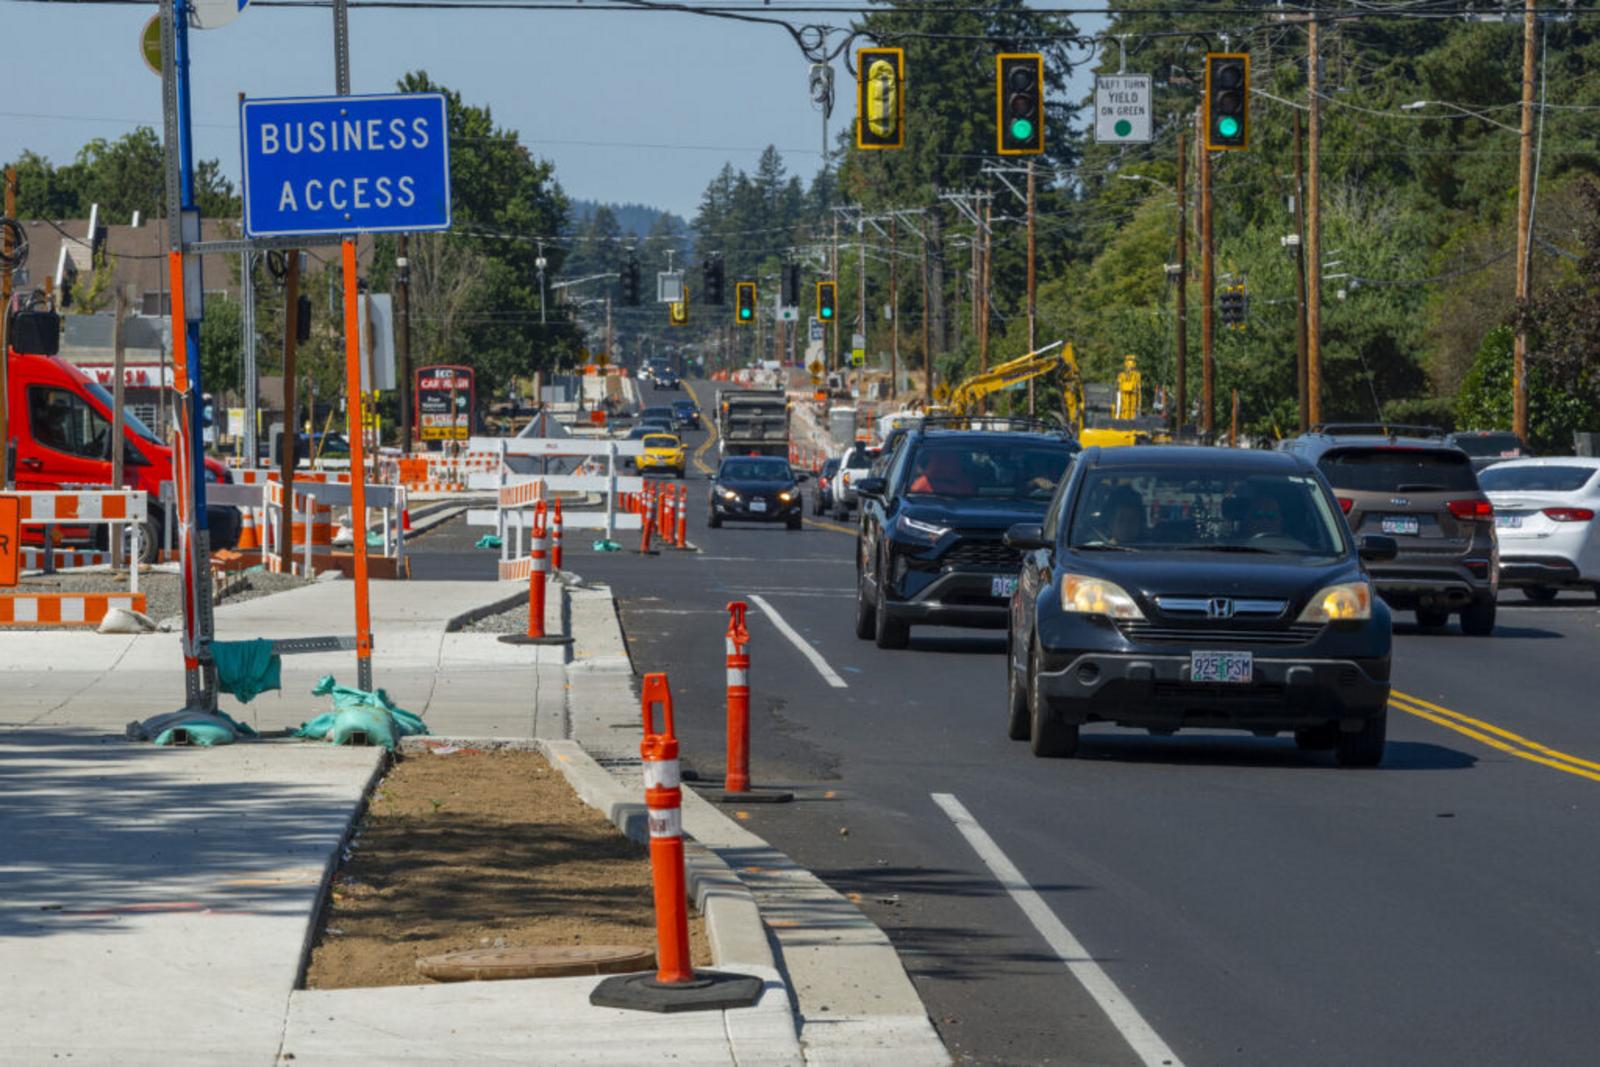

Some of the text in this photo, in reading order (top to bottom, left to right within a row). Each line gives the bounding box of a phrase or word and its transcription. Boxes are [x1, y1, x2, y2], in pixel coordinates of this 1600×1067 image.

[1100, 79, 1146, 89] LEFT TURN
[1108, 91, 1139, 104] YIELD
[1101, 105, 1145, 116] ON GREEN
[261, 117, 429, 154] BUSINESS
[278, 176, 415, 212] ACCESS
[95, 369, 147, 385] WSH
[1195, 658, 1250, 675] 925 PSM
